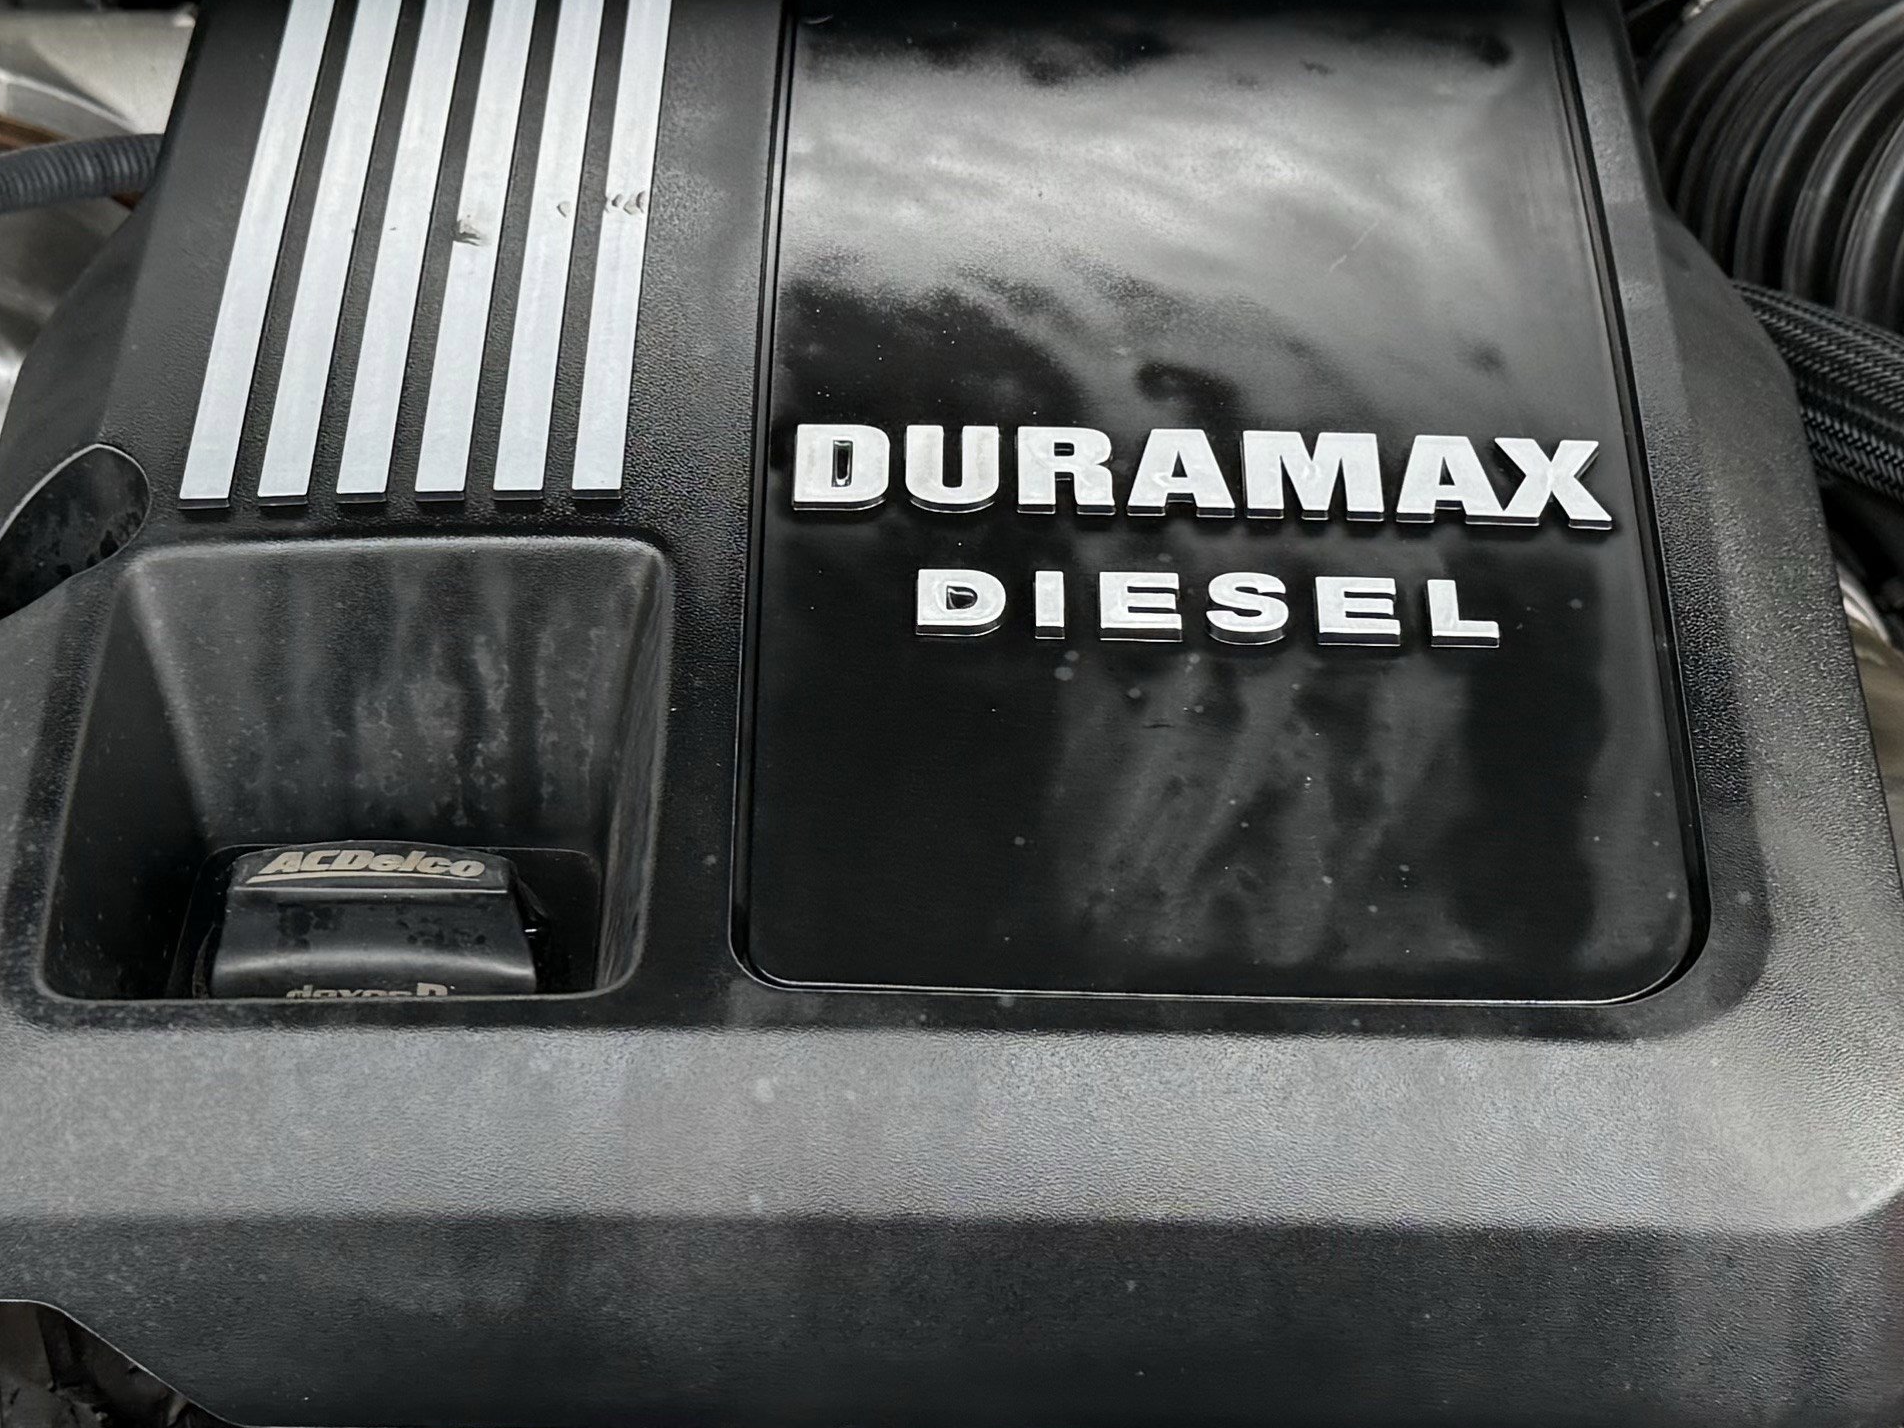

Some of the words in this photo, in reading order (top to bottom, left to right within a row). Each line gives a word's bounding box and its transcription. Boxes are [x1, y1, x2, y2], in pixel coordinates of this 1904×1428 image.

[791, 423, 1613, 531] DURAMAX
[914, 568, 1501, 648] DIESEL
[258, 848, 486, 878] ACDelco
